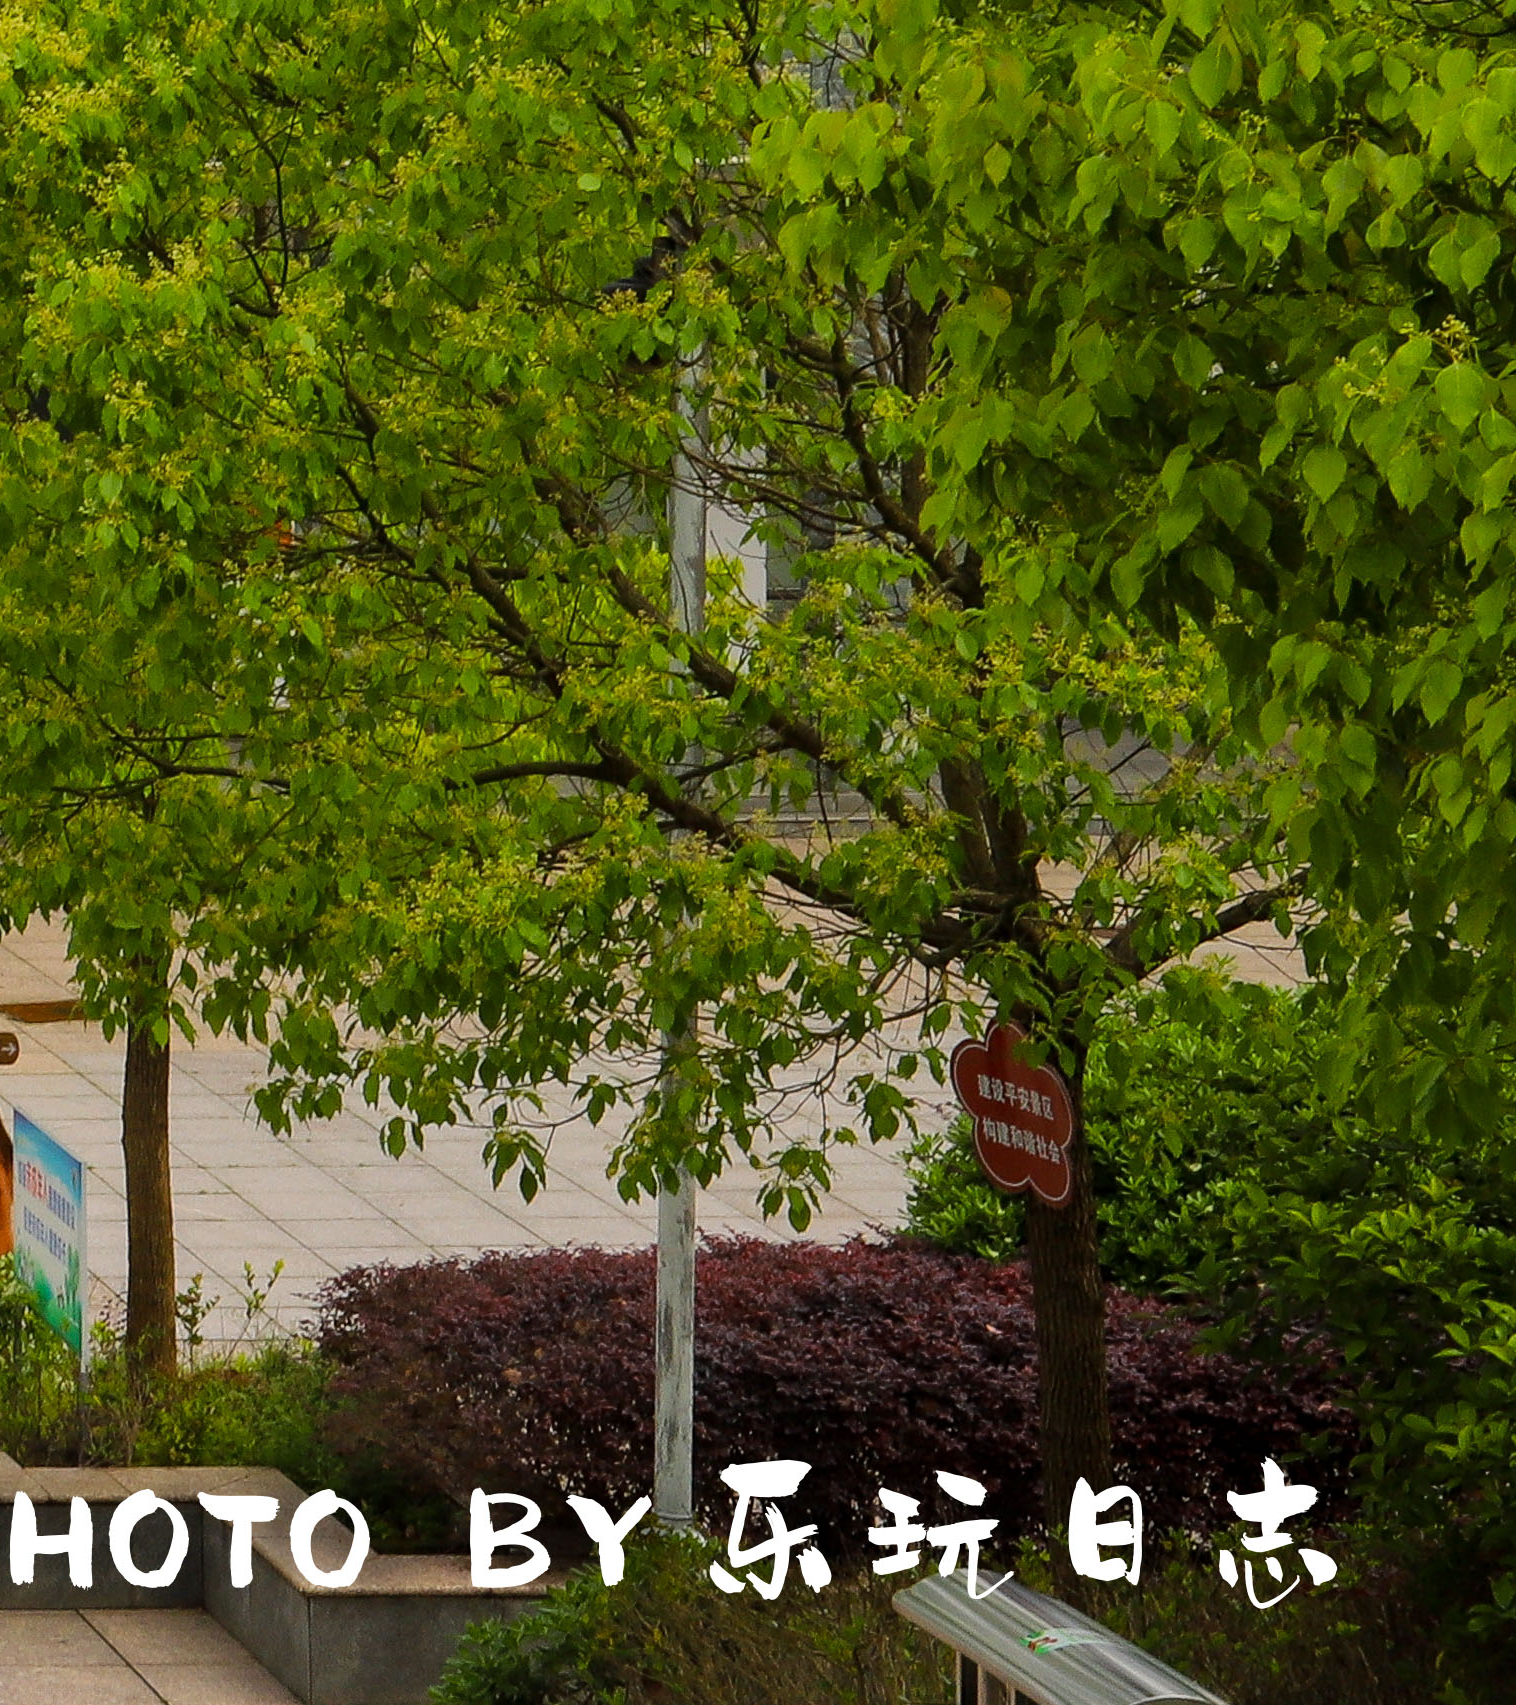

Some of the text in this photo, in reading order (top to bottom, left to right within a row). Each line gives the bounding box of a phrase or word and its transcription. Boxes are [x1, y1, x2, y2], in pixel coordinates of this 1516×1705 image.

[982, 1116, 1061, 1165] 构建和谐社会
